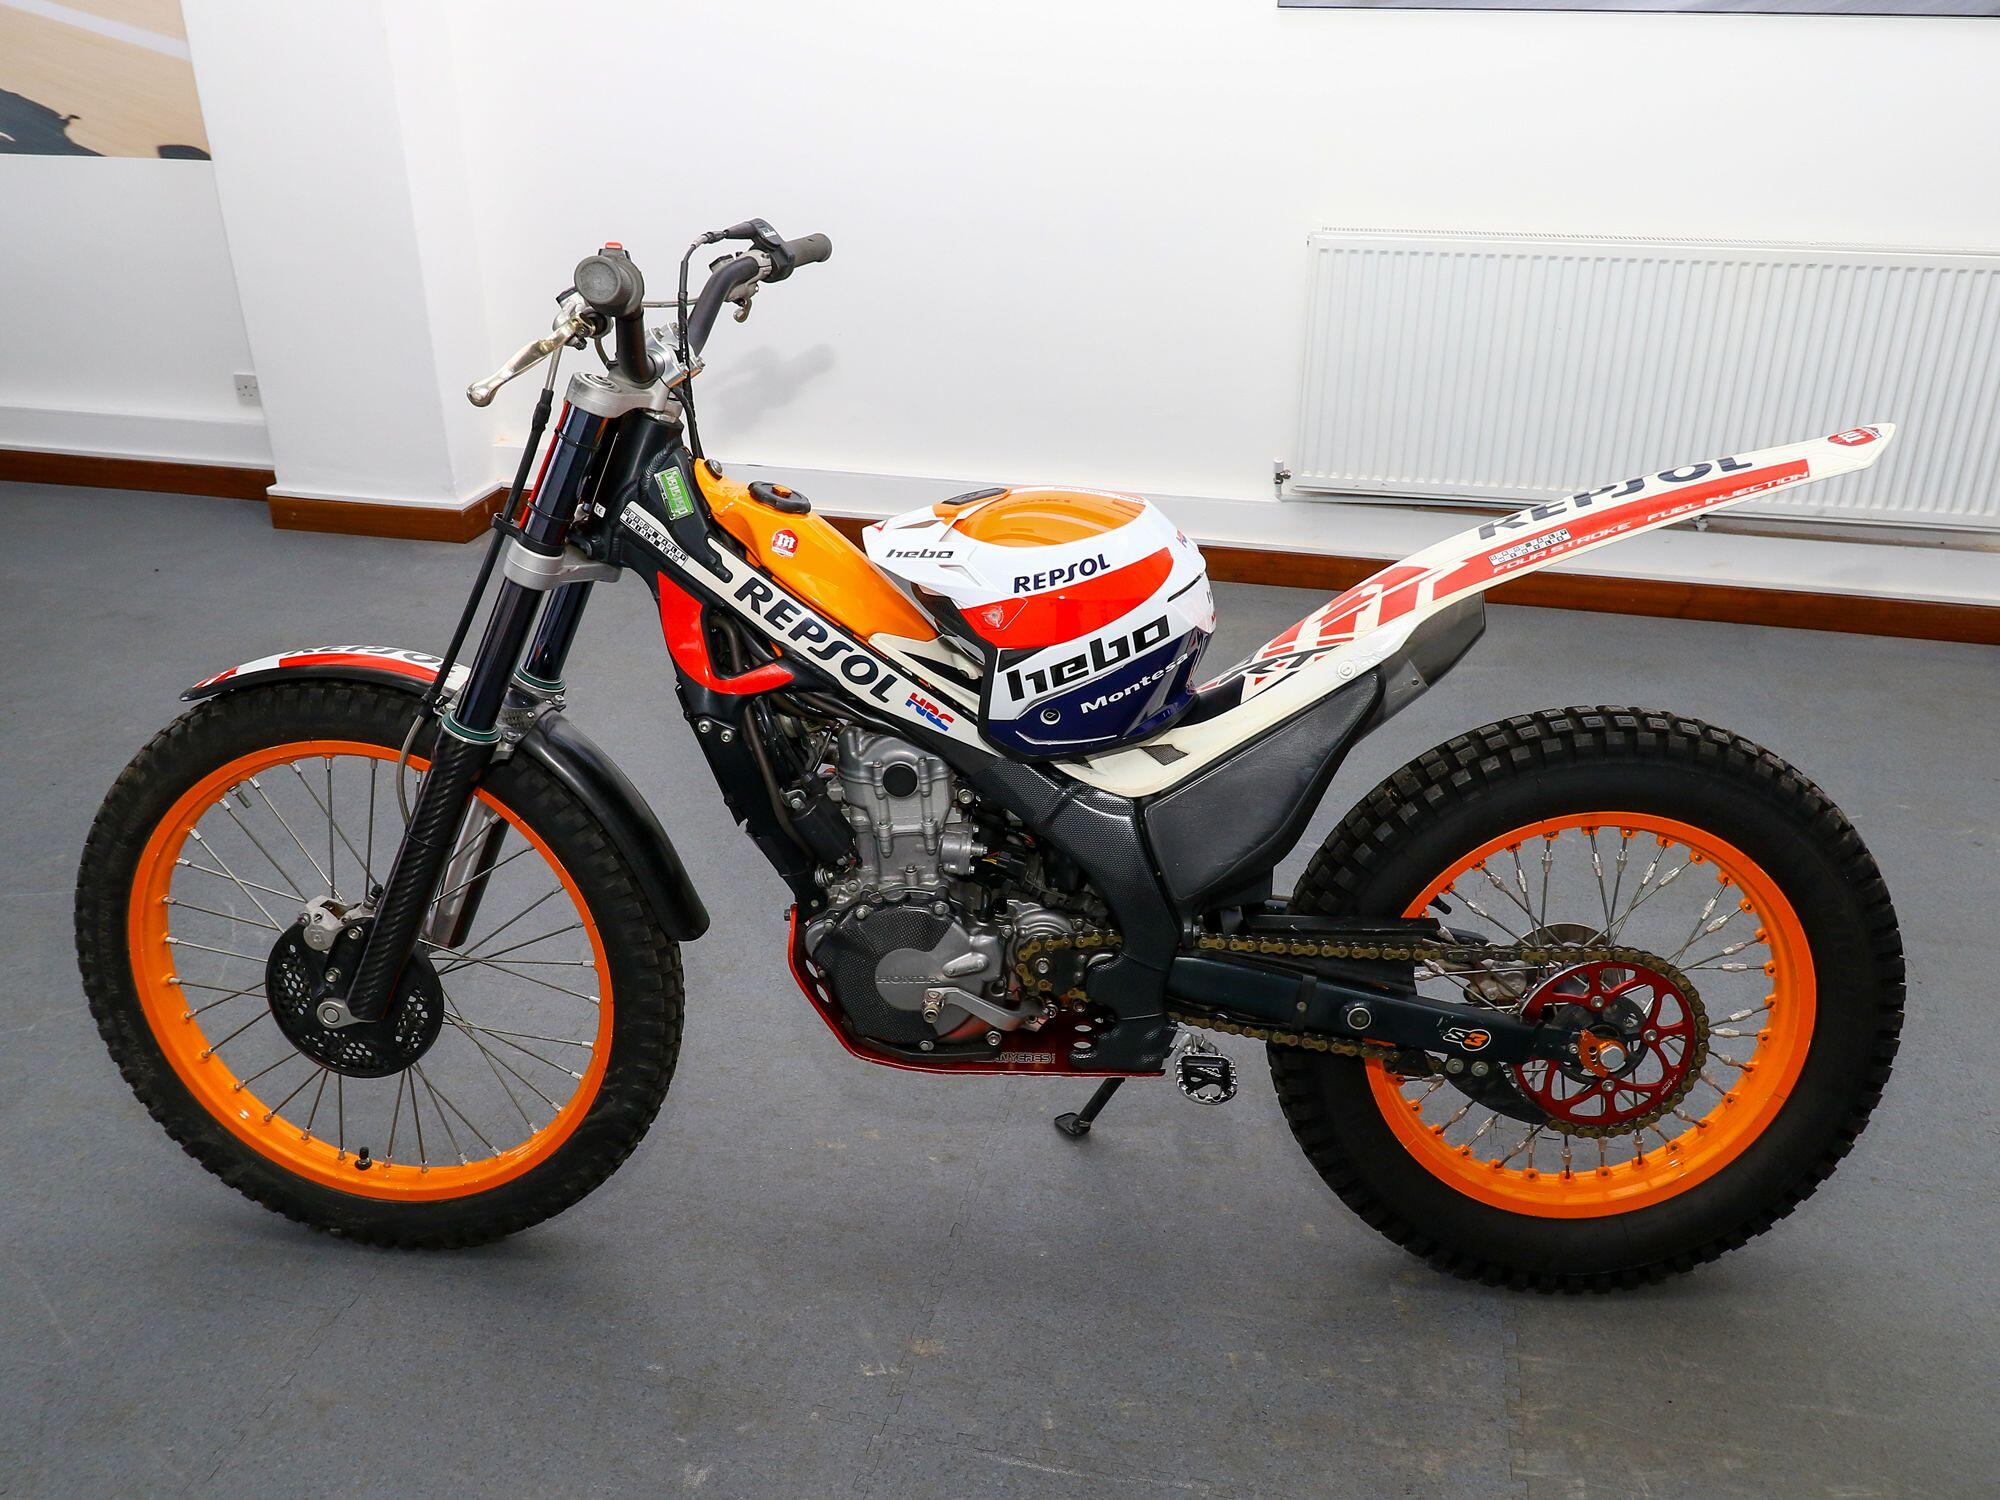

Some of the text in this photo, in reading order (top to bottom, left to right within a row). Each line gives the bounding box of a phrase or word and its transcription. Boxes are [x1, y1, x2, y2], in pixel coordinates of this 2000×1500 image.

[624, 509, 687, 562] GORDON FARLEY
[626, 517, 680, 562] TRIALS TEAM
[1493, 472, 1809, 574] FOUR STROKE FUEL INJECTION
[1013, 553, 1111, 593] REPSOL
[733, 577, 899, 704] REPSOL
[1005, 614, 1172, 702] hebo
[1080, 653, 1188, 715] Montesa
[904, 692, 955, 732] HRC
[876, 975, 943, 984] HONDA
